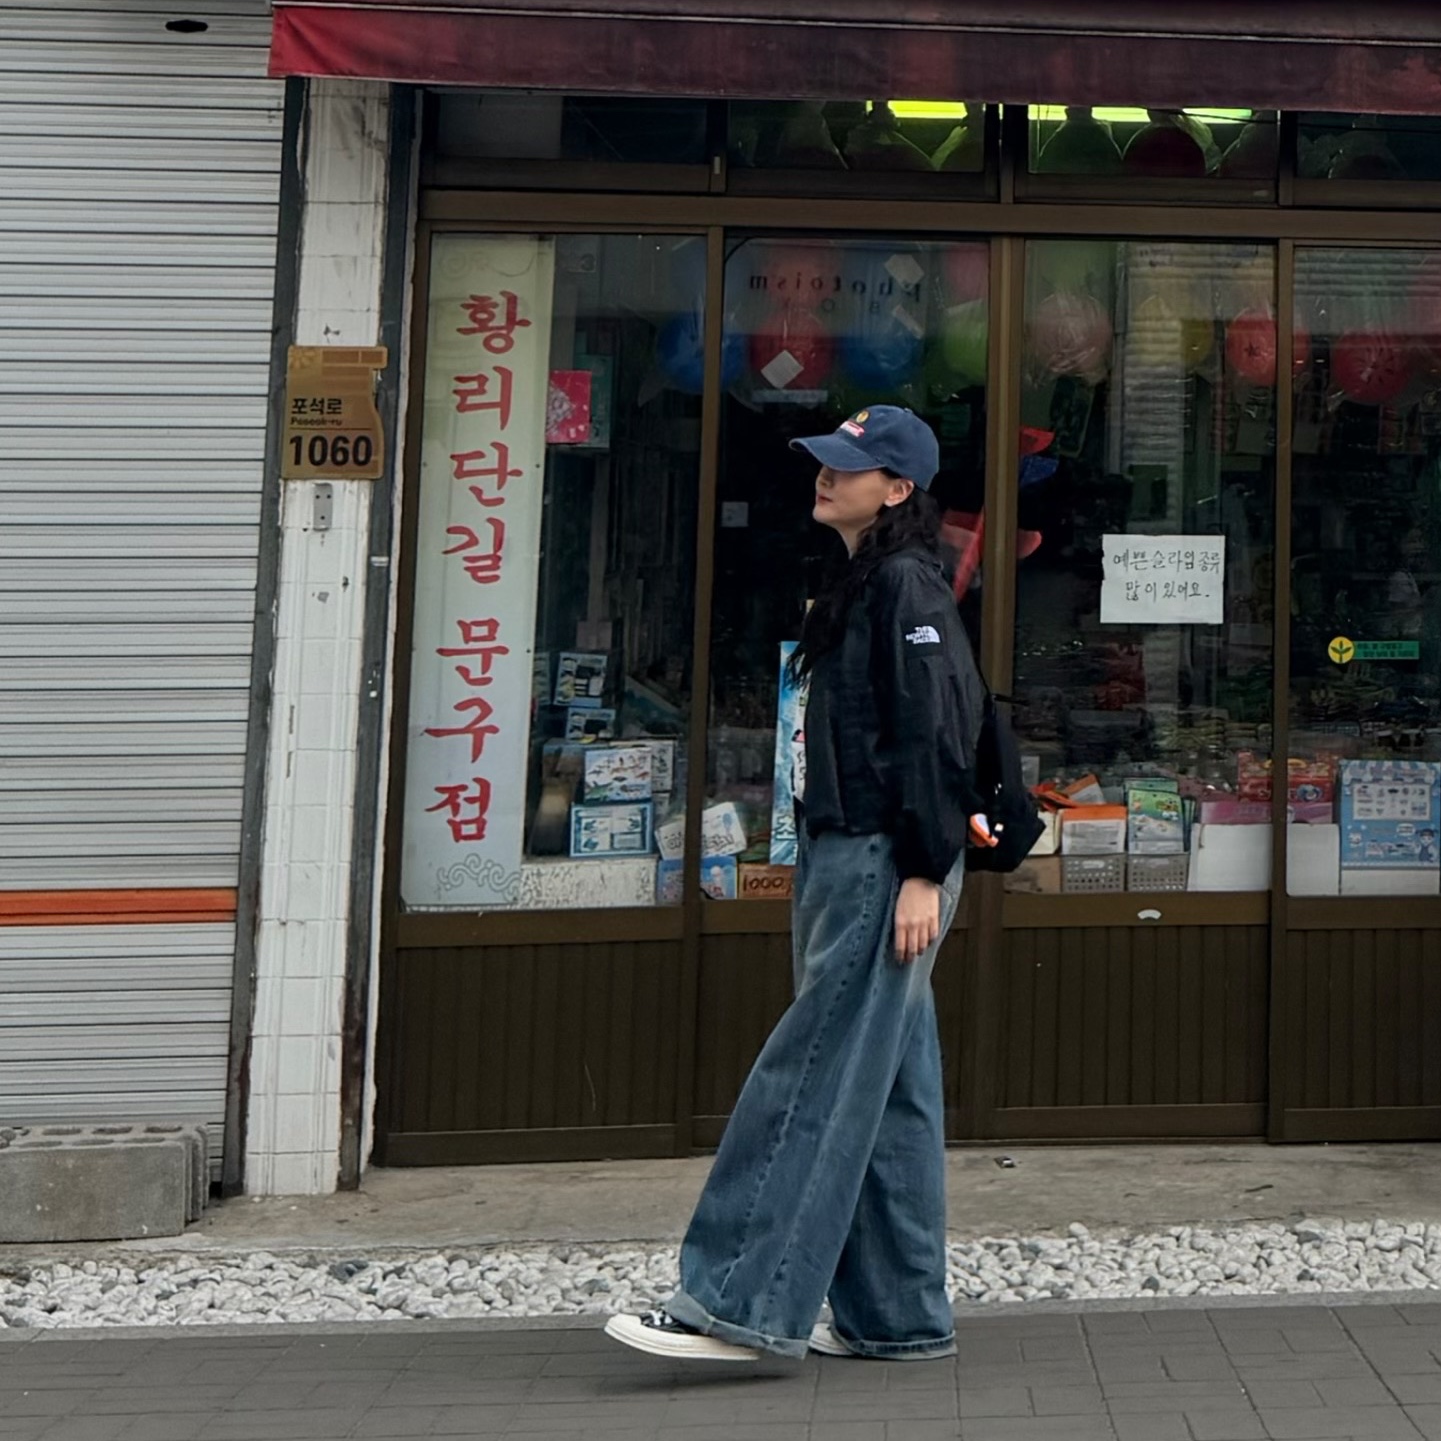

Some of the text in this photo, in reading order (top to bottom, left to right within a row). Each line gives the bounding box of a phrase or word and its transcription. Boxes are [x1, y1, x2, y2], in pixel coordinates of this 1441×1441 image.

[291, 397, 343, 415] 포석로
[289, 434, 373, 467] 1060
[424, 290, 532, 843] 황리단길 문구점
